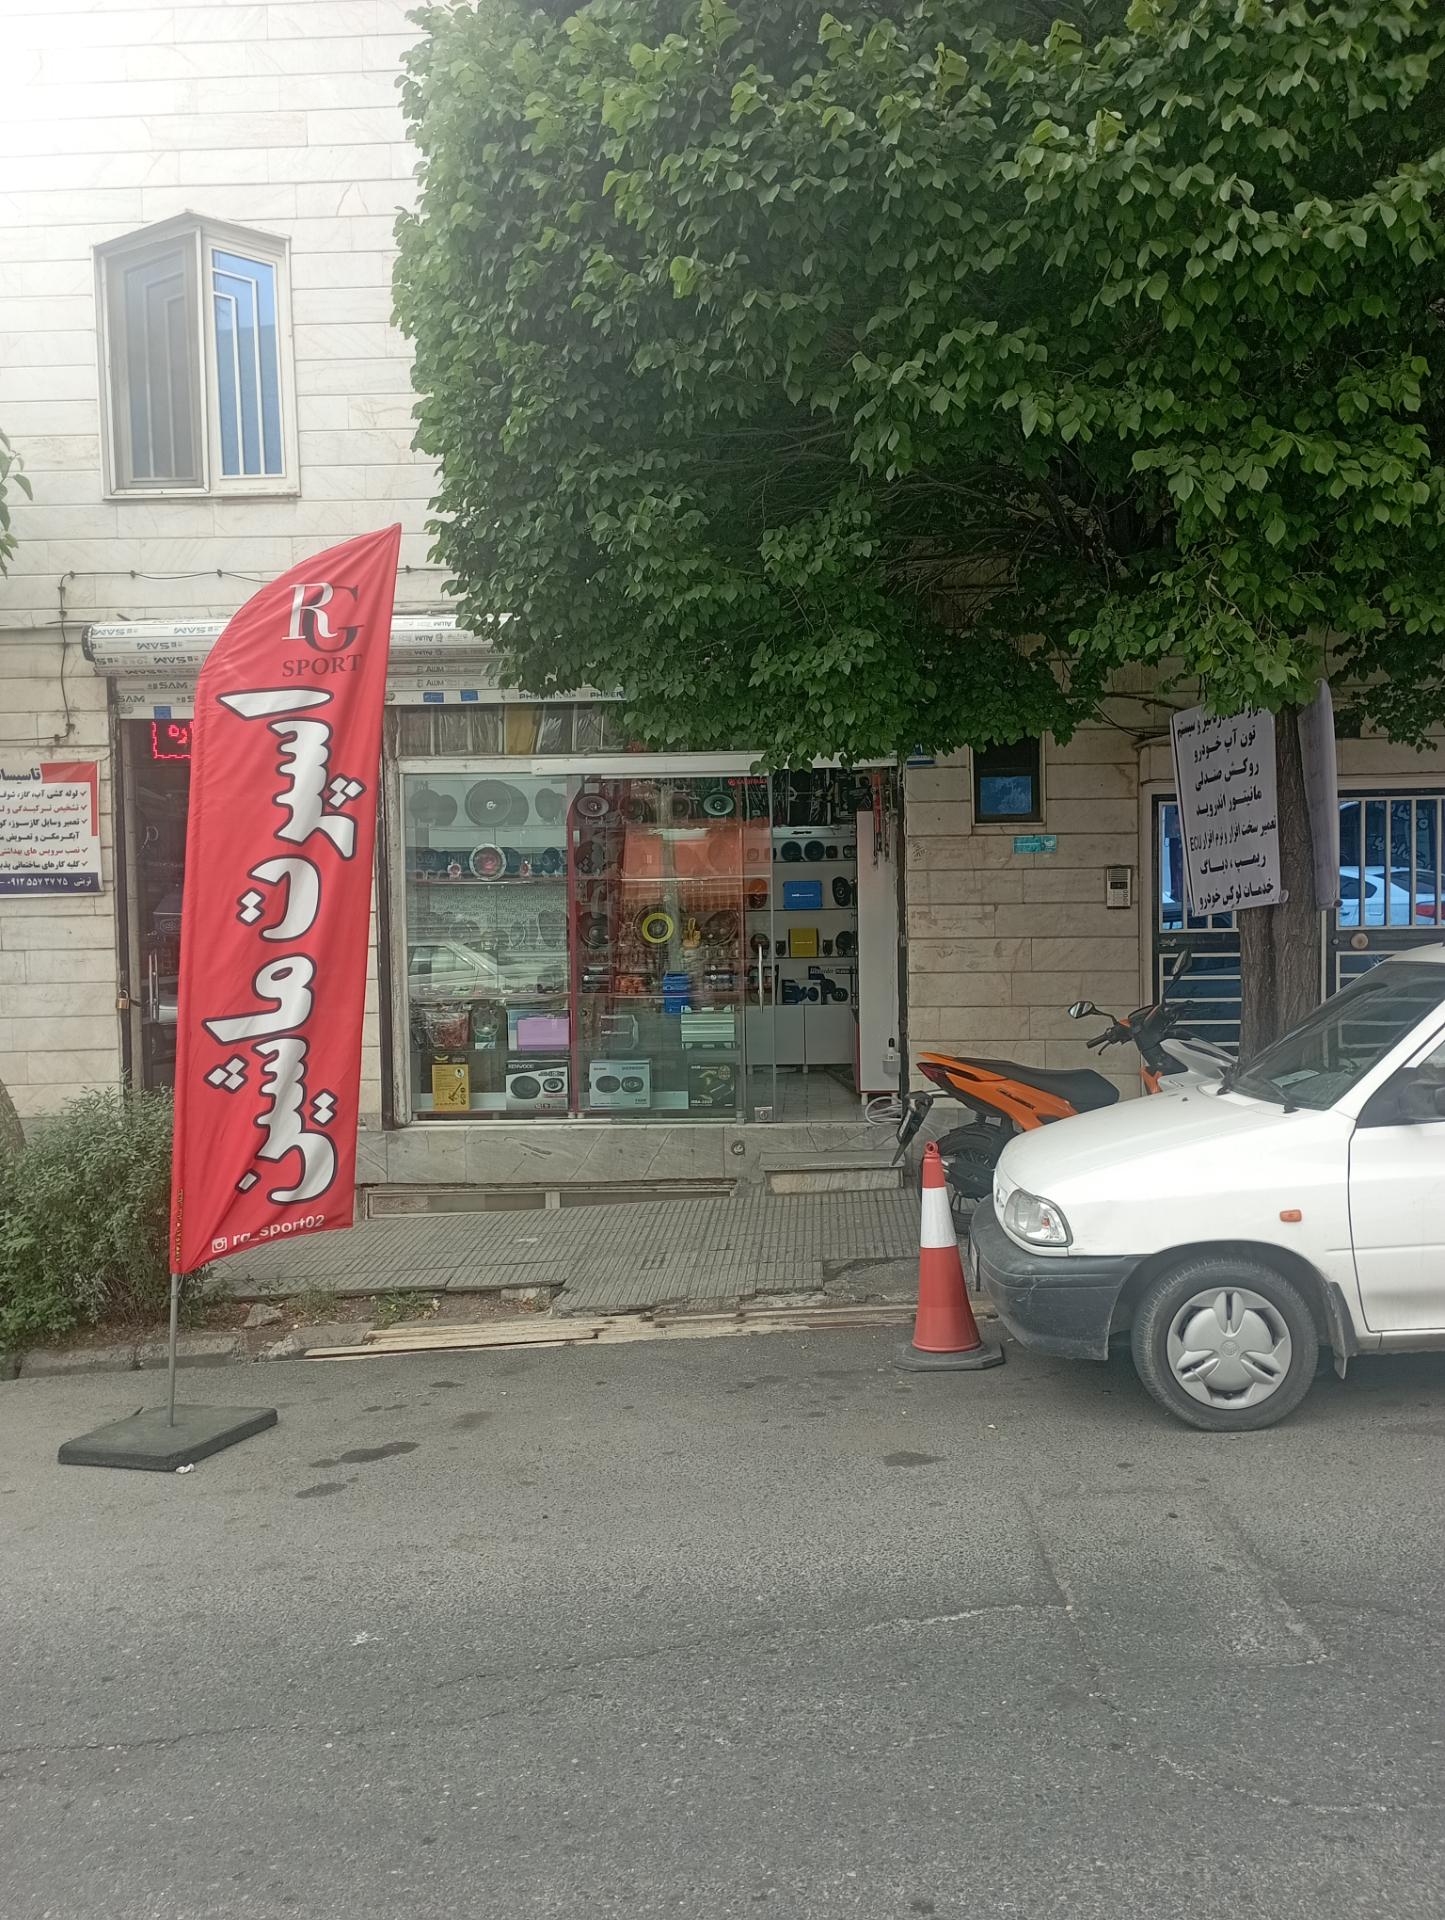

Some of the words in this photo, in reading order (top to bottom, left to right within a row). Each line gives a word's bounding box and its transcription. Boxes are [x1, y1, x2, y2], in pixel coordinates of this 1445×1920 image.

[174, 626, 206, 634] SAM
[137, 642, 170, 650] SAM
[154, 656, 187, 664] SAM
[281, 654, 364, 678] SPORT
[1194, 735, 1222, 763] خودرو
[0, 767, 41, 784] تاسیسا
[1195, 767, 1222, 791] صندلی
[1225, 757, 1259, 782] روکش
[46, 790, 63, 799] کشی
[65, 789, 78, 799] لوله
[1229, 784, 1263, 812] مانیتور
[216, 687, 367, 941] اسپرت
[1196, 793, 1226, 817] اندروید
[41, 818, 61, 828] وسایل
[63, 818, 79, 828] تعمیر
[1260, 815, 1276, 836] تعمیر
[66, 860, 80, 869] کلیه
[1222, 884, 1242, 905] لوکس
[1243, 877, 1274, 898] خدمات
[1199, 888, 1221, 910] خودرو
[201, 953, 338, 1204] ماشین
